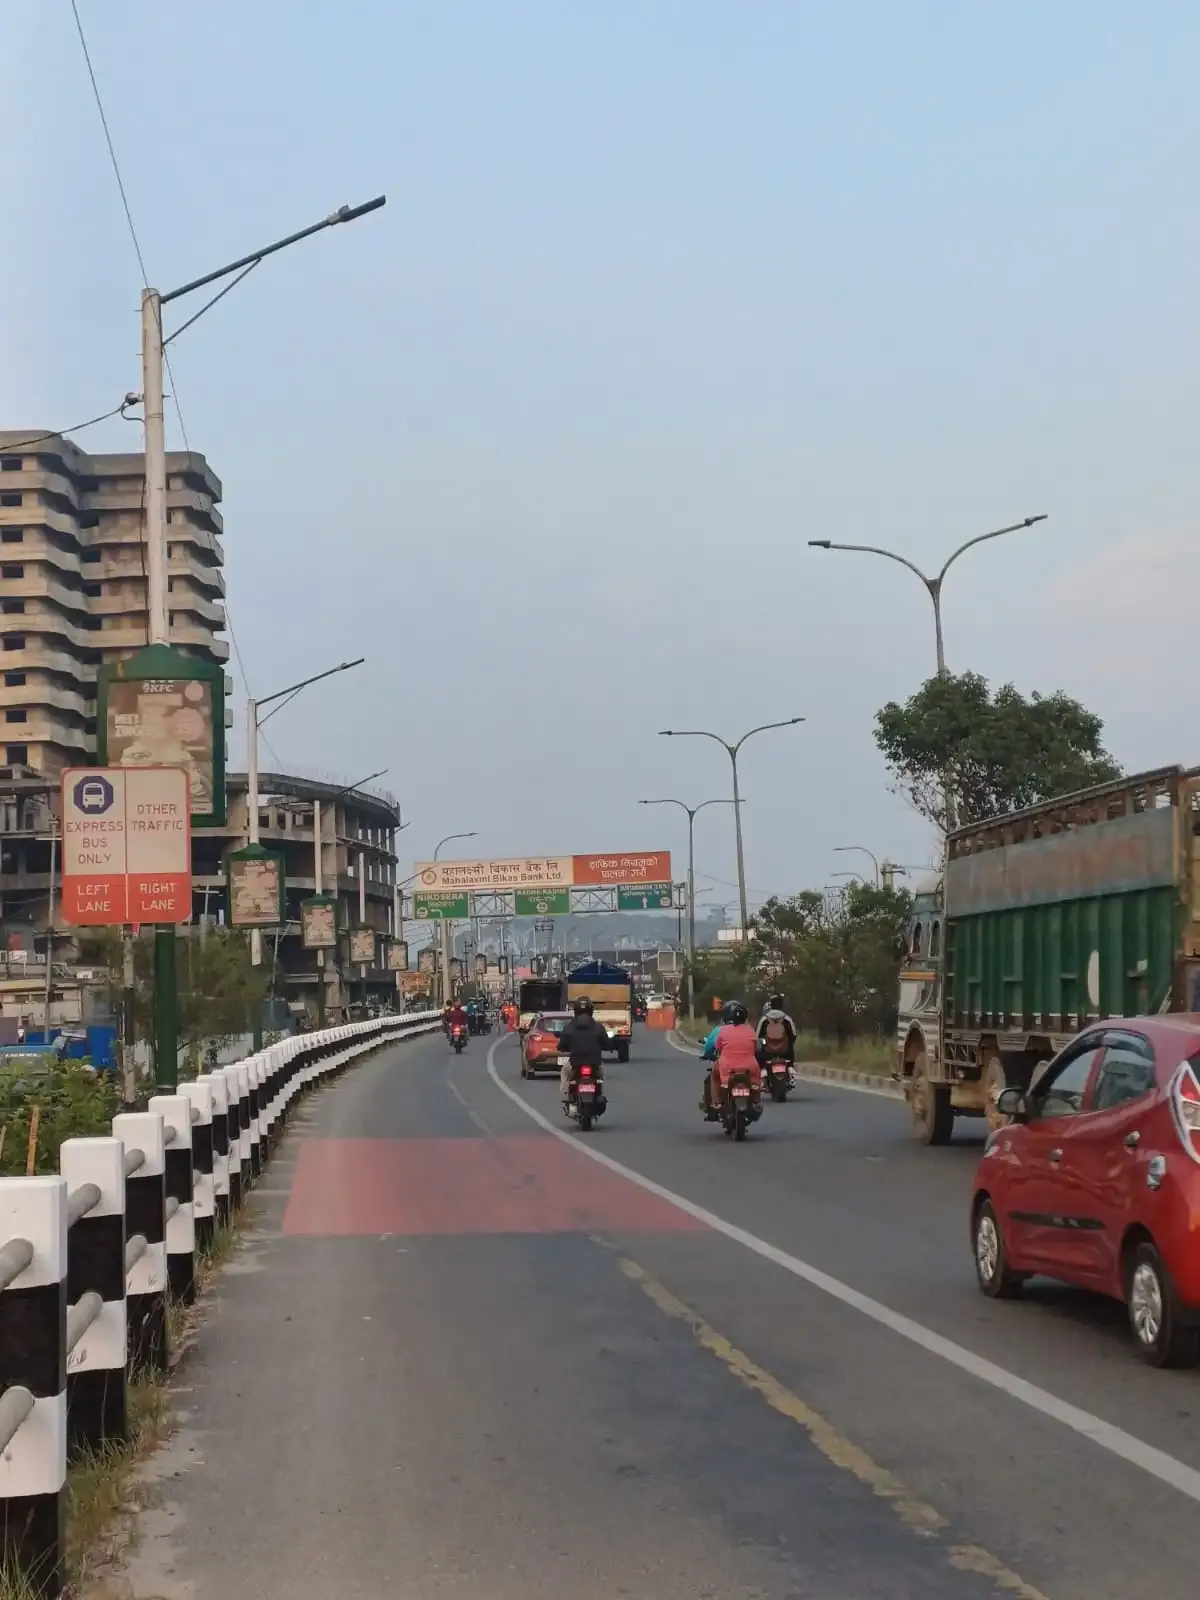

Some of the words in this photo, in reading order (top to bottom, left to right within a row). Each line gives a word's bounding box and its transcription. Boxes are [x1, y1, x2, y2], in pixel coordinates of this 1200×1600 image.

[150, 684, 174, 693] KFC
[136, 803, 177, 815] OTHER
[66, 821, 123, 833] EXPRESS
[132, 819, 184, 831] TRAFFIC
[82, 837, 108, 848] BUS
[78, 853, 111, 864] ONLY
[442, 875, 490, 885] Mahalaxmi
[493, 873, 518, 883] Bikas
[521, 872, 543, 881] Bank
[77, 884, 111, 896] LEFT
[140, 882, 177, 895] RIGHT
[76, 901, 111, 913] LANE
[141, 899, 175, 911] LANE
